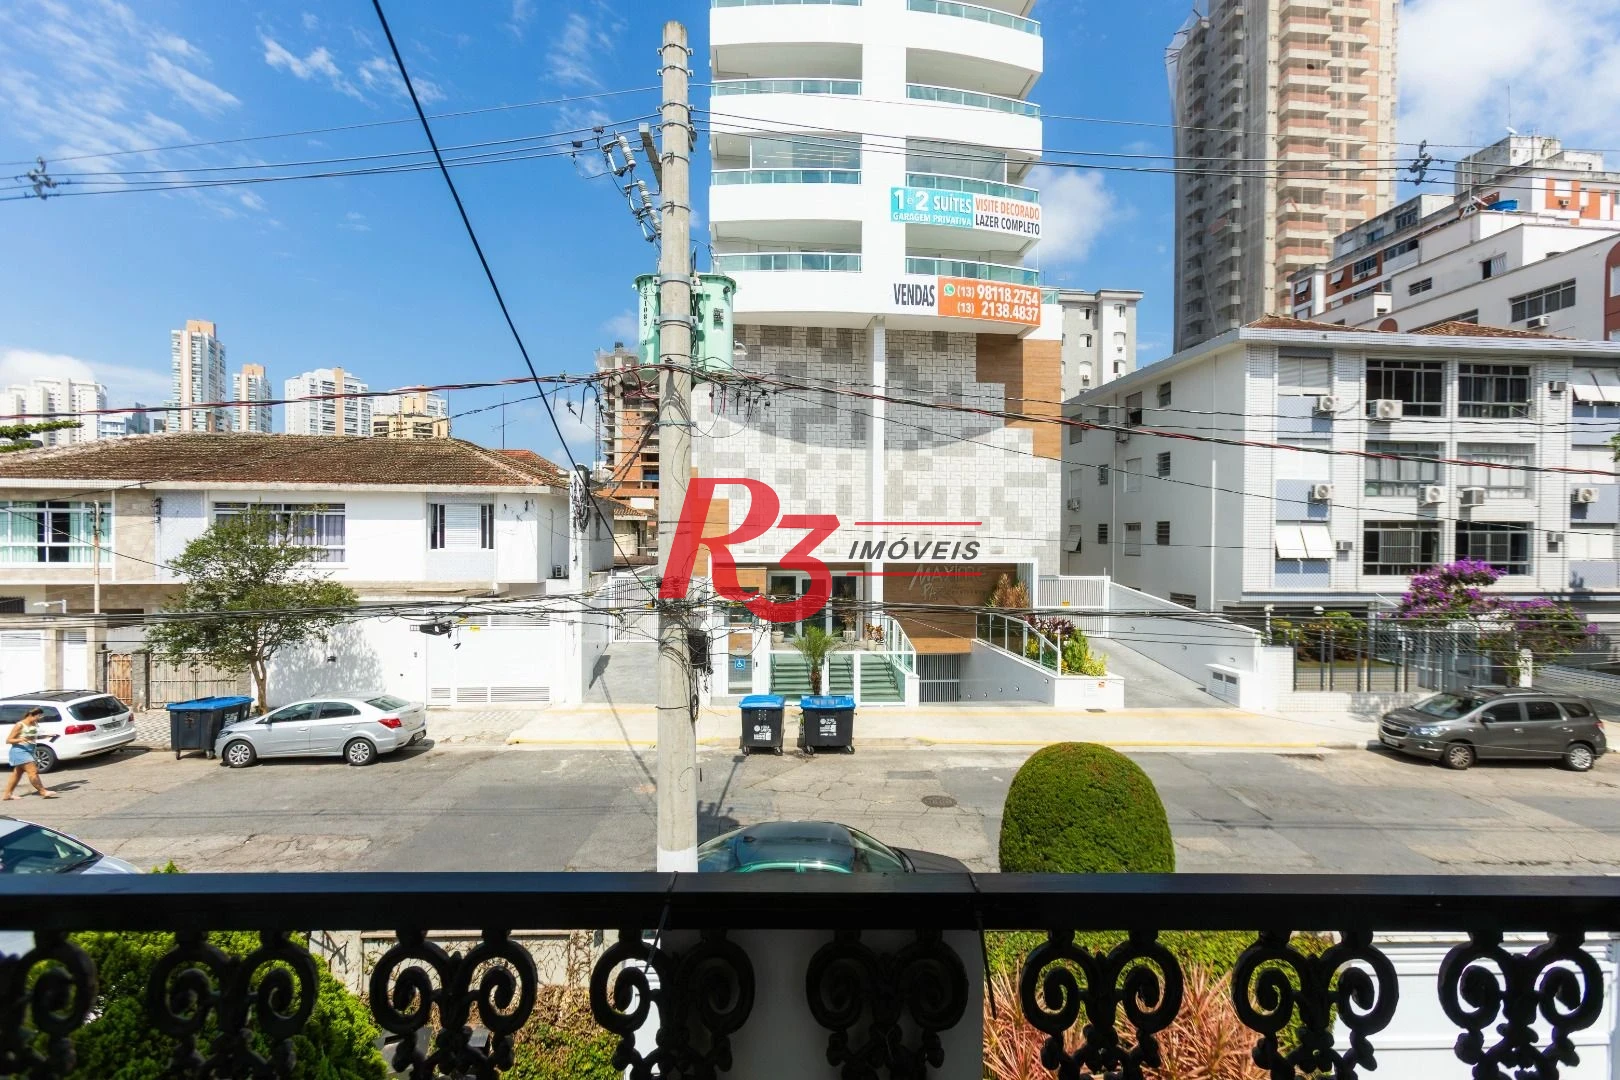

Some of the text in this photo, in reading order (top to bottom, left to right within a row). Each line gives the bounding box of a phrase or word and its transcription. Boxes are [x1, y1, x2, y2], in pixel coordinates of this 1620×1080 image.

[894, 189, 904, 210] 1
[915, 190, 929, 212] 2
[975, 197, 1040, 220] VISITE DECORADO
[893, 212, 972, 227] GARAGEM PRIVATIVA
[975, 213, 1040, 236] LAZER COMPLETO
[893, 283, 935, 308] VENDAS
[957, 284, 1039, 306] (13) 98118.2754
[957, 301, 1039, 322] (13) 2138.4837
